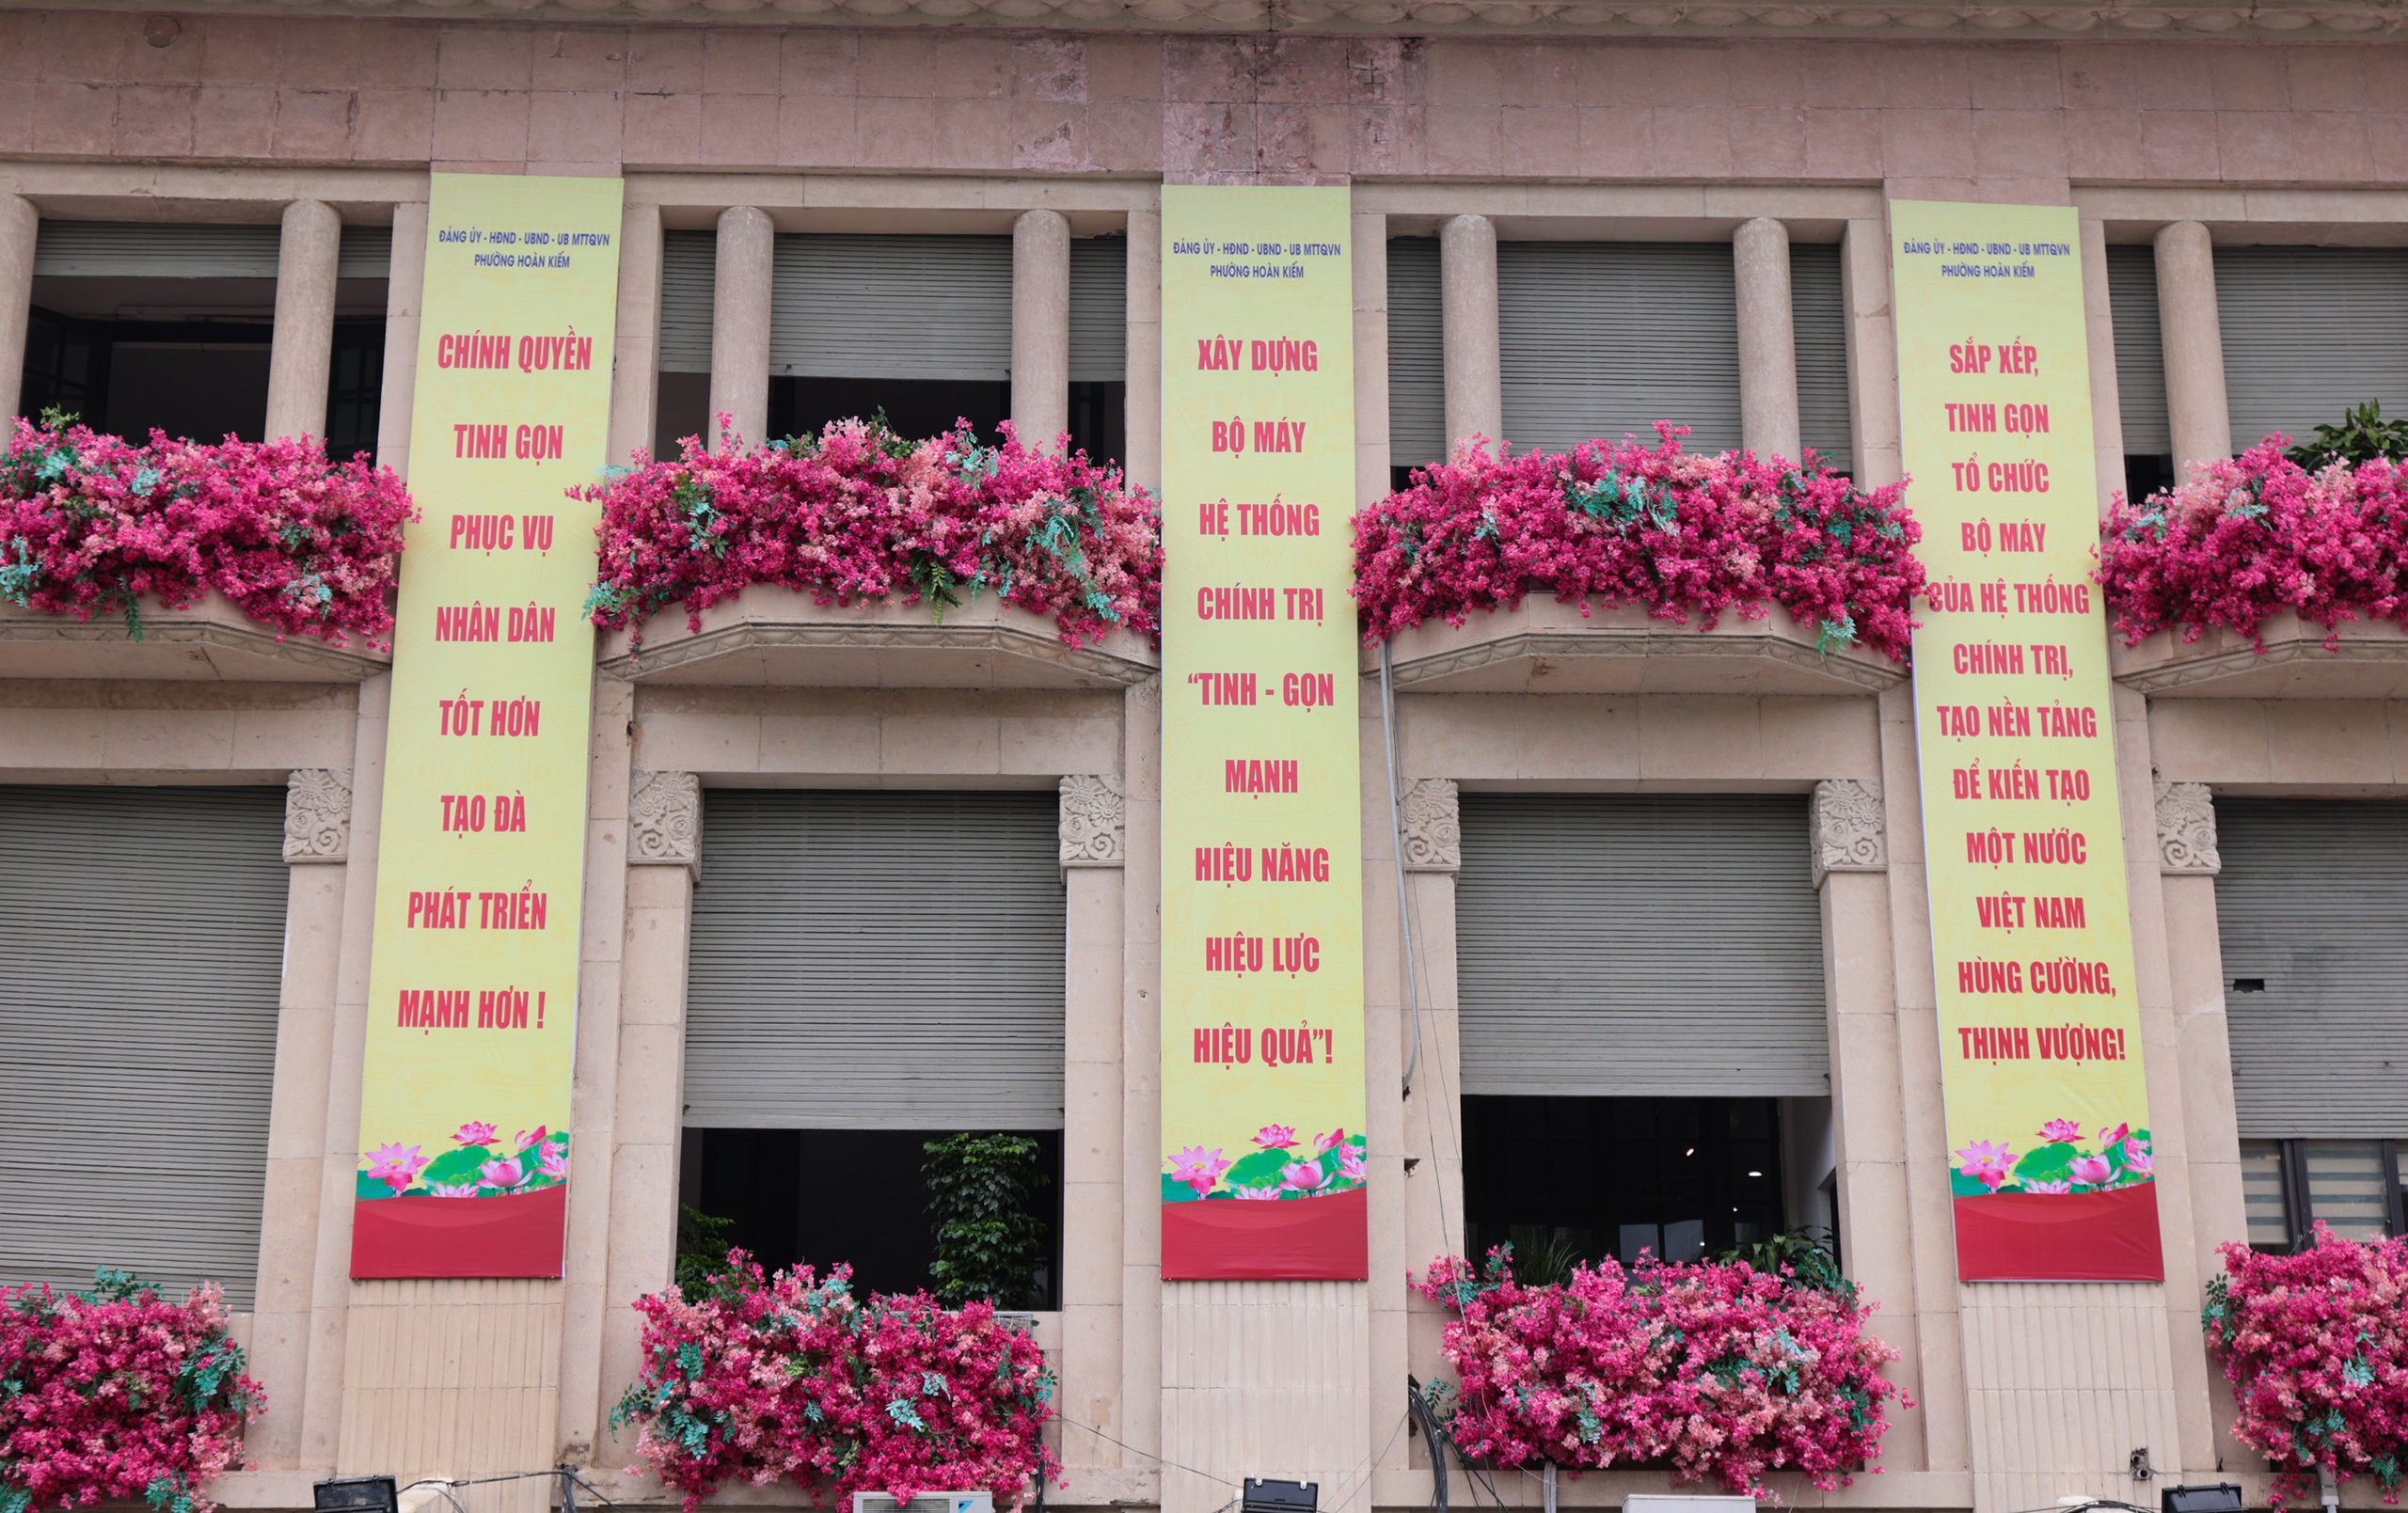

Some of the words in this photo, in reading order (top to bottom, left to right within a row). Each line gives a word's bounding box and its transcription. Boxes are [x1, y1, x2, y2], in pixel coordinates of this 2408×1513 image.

[489, 232, 516, 244] HĐND
[525, 233, 549, 244] UBND
[558, 233, 568, 244] UB
[572, 233, 610, 245] MTTQVN
[1223, 243, 1248, 255] HĐND
[1257, 244, 1281, 255] UBND
[1290, 244, 1301, 255] UB
[1304, 244, 1340, 256] MTTQVN
[1954, 243, 1978, 254] HĐND
[1987, 244, 2011, 255] UBND
[2020, 244, 2030, 255] UB
[2034, 244, 2070, 255] MTTQVN
[474, 251, 515, 267] PHƯỜNG
[517, 252, 545, 267] HOÀN
[548, 251, 570, 268] KIẾM
[1211, 262, 1249, 277] PHƯỜNG
[1253, 263, 1279, 277] HOÀN
[1283, 260, 1304, 278] KIẾM
[1941, 262, 1981, 276] PHƯỜNG
[1984, 263, 2010, 277] HOÀN
[2014, 261, 2035, 277] KIẾM
[438, 331, 511, 369] CHÍNH
[519, 326, 592, 373] QUYỀN
[1198, 335, 1243, 370] XÂY
[1252, 337, 1318, 376] DỰNG
[1950, 337, 1991, 373] SẮP
[1999, 337, 2038, 375] XẾP,
[1212, 416, 1245, 457] BỘ
[1255, 418, 1306, 452] MÁY
[1944, 403, 1997, 433] TINH
[2004, 403, 2049, 438] GỌN
[454, 424, 507, 459] TINH
[516, 424, 563, 465] GỌN
[1952, 453, 1980, 492] TỔ
[1988, 459, 2050, 493] CHỨC
[451, 514, 514, 556] PHỤC
[523, 515, 553, 556] VỤ
[1200, 498, 1228, 541] HỆ
[1237, 494, 1320, 536] THỐNG
[1961, 517, 1991, 557] BỘ
[2000, 519, 2046, 553] MÁY
[1197, 583, 1275, 620] CHÍNH
[1284, 588, 1323, 626] TRỊ
[1929, 575, 1974, 612] CỦA
[1980, 578, 2008, 618] HỆ
[2014, 573, 2091, 614] THỐNG
[436, 601, 499, 641] NHÂN
[508, 602, 555, 642] DÂN
[1954, 639, 2024, 674] CHÍNH
[2030, 645, 2073, 680] TRỊ,
[439, 688, 484, 736] TỐT
[490, 696, 540, 736] HƠN
[1188, 673, 1256, 705] “TINH
[1283, 673, 1334, 712] GỌN
[1937, 705, 1980, 741] TẠO
[1988, 697, 2031, 736] NỀN
[2037, 701, 2097, 737] TẢNG
[1226, 760, 1298, 799] MẠNH
[1954, 758, 1982, 799] ĐỂ
[1988, 760, 2039, 799] KIẾN
[2046, 769, 2090, 806] TẠO
[441, 795, 486, 839] TẠO
[494, 791, 526, 832] ĐÀ
[1196, 842, 1252, 888] HIỆU
[1262, 843, 1329, 882] NĂNG
[1966, 827, 2016, 869] MỘT
[2023, 827, 2086, 864] NƯỚC
[407, 887, 471, 929] PHÁT
[479, 879, 547, 930] TRIỂN
[1976, 891, 2026, 934] VIỆT
[2034, 897, 2086, 929] NAM
[1206, 931, 1263, 978] HIỆU
[1274, 933, 1320, 978] LỰC
[1958, 957, 2022, 993] HÙNG
[2030, 957, 2116, 997] CƯỜNG,
[398, 990, 470, 1034] MẠNH
[478, 985, 529, 1029] HƠN
[537, 991, 546, 1029] !
[1194, 1022, 1251, 1069] HIỆU
[1261, 1020, 1333, 1067] QUẢ”!
[1958, 1027, 2030, 1064] THỊNH
[2036, 1023, 2126, 1065] VƯỢNG!
